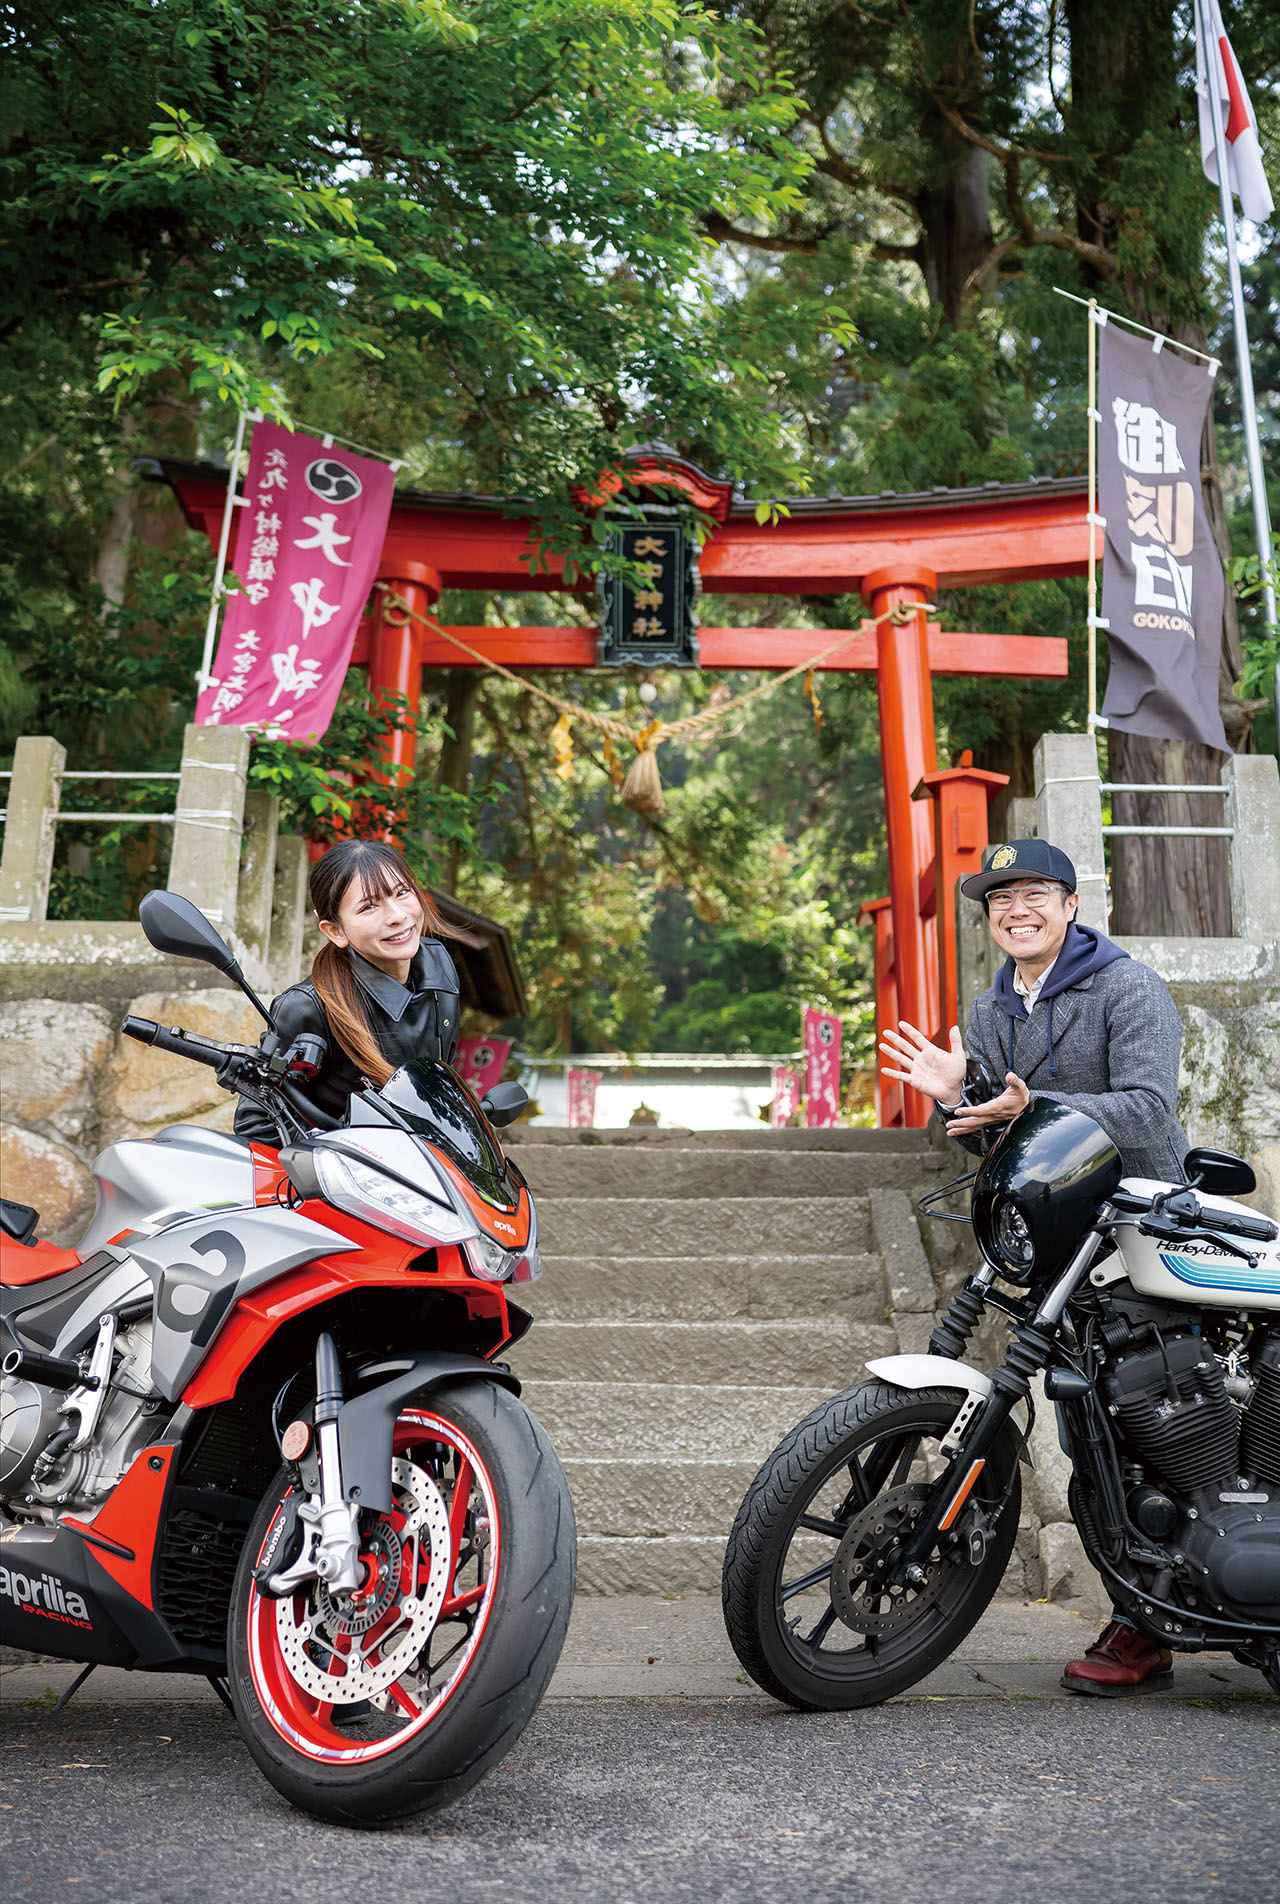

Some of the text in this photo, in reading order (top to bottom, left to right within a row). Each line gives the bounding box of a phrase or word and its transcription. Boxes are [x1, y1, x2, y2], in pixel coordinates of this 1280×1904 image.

[1112, 396, 1195, 617] 御刻印
[494, 1220, 517, 1236] aprilia
[1156, 1240, 1267, 1260] Harley-Davon
[261, 1515, 287, 1567] brembo
[0, 1566, 90, 1621] aprilia
[21, 1602, 95, 1631] RACING
